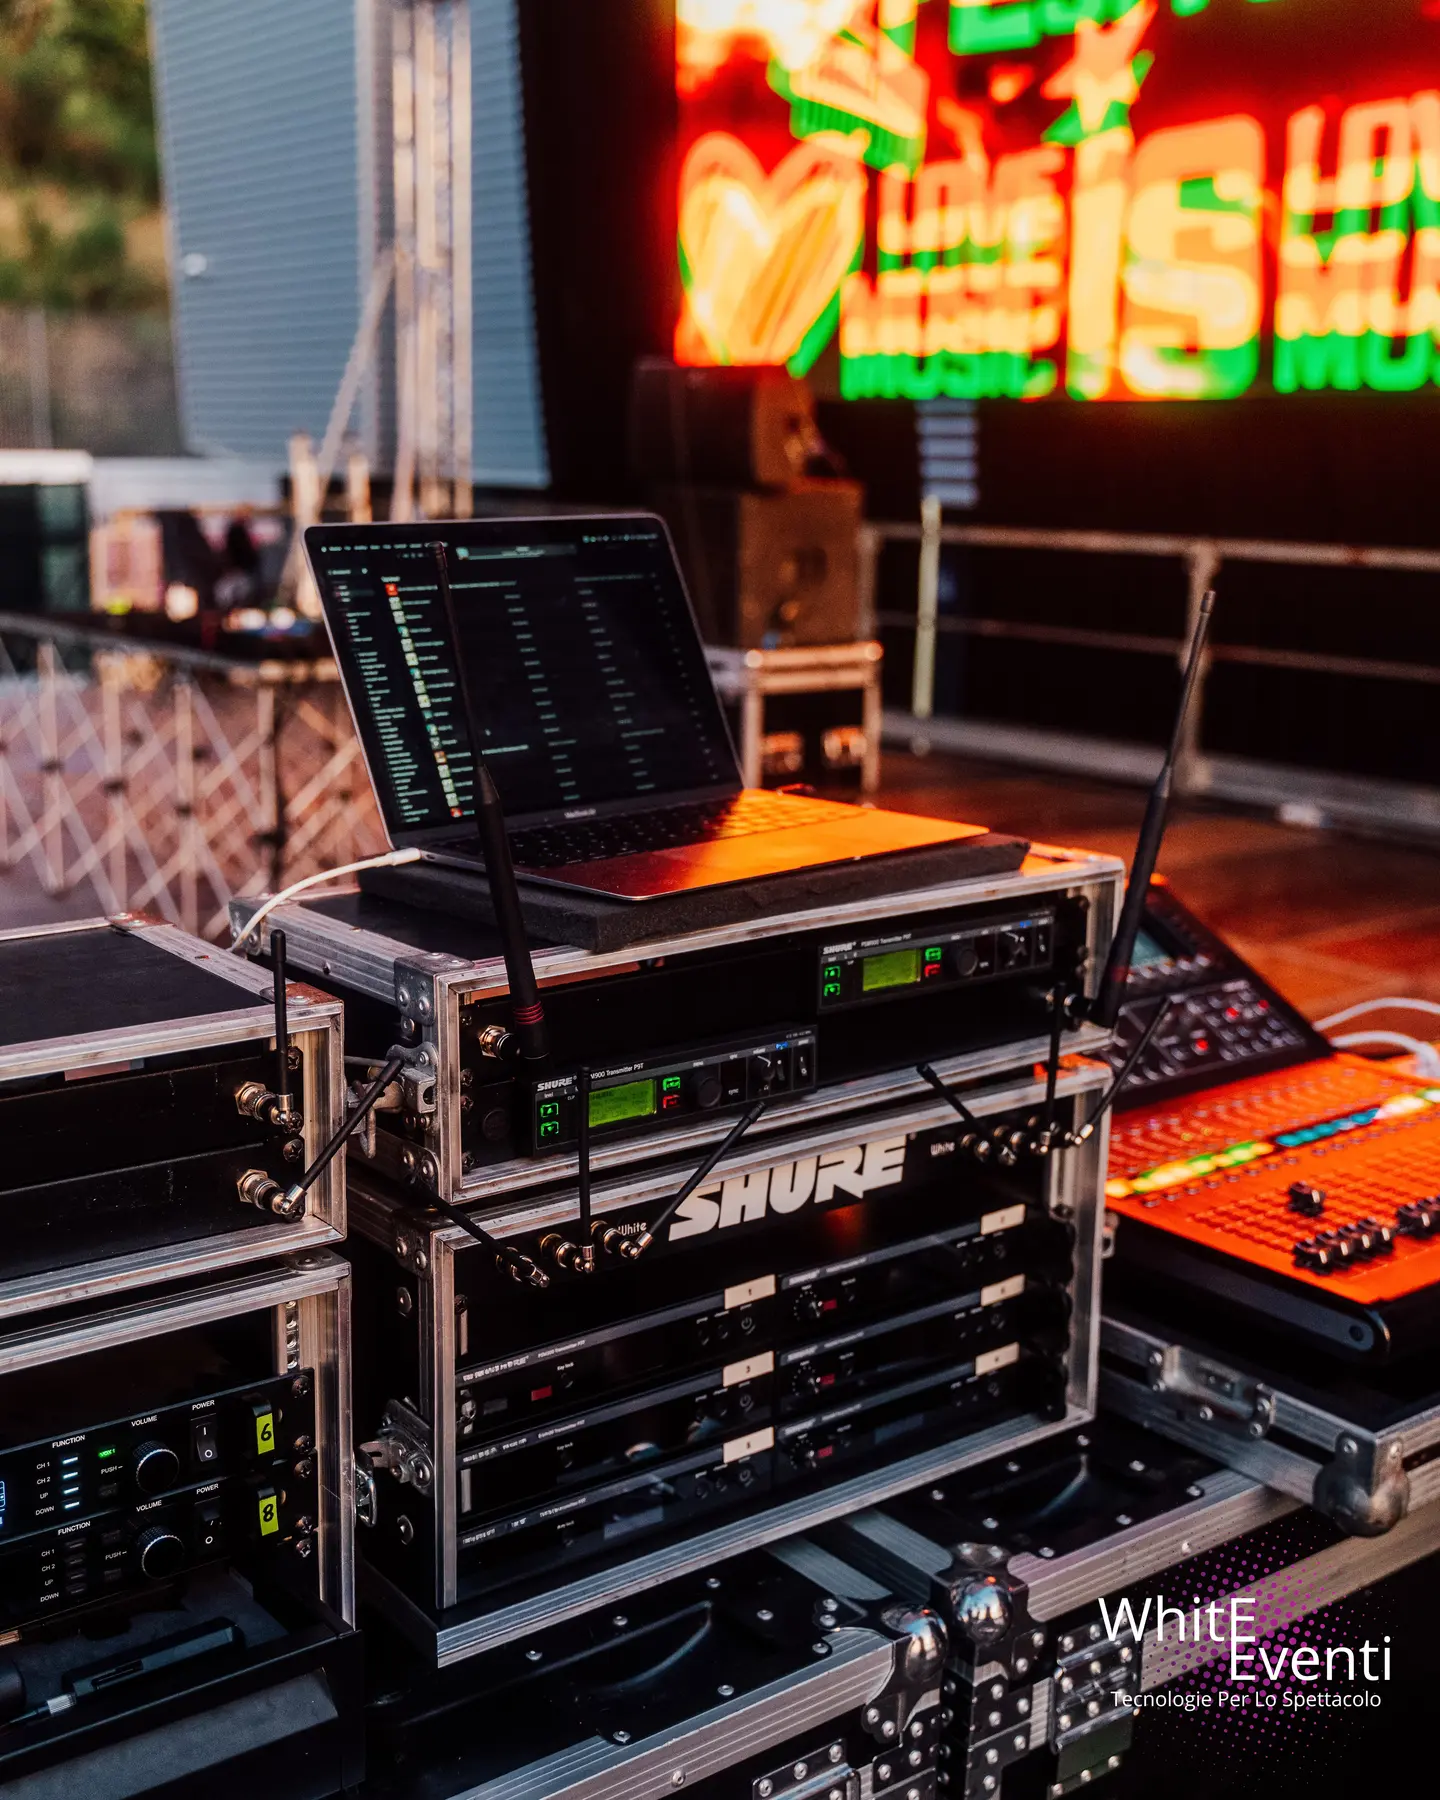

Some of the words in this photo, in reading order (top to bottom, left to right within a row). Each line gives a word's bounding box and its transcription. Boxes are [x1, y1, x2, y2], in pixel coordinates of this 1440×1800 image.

[1066, 112, 1264, 401] IS
[1272, 226, 1440, 394] MU
[536, 1076, 573, 1092] SHURE
[606, 1065, 633, 1077] Transmitter
[668, 1133, 907, 1241] SHURE
[192, 1399, 215, 1411] POWER
[131, 1414, 158, 1427] VOLUME
[260, 1423, 273, 1442] 6
[52, 1434, 86, 1449] FUNCTION
[36, 1462, 46, 1470] CH
[100, 1465, 118, 1475] PUSH
[36, 1477, 47, 1485] CH
[196, 1482, 219, 1495] POWER
[39, 1492, 49, 1500] UP
[35, 1505, 55, 1516] DOWN
[136, 1499, 162, 1513] VOLUME
[262, 1503, 274, 1522] 8
[57, 1520, 91, 1536] FUNCTION
[105, 1550, 122, 1560] PUSH
[41, 1564, 51, 1572] CH
[44, 1578, 54, 1586] UP
[40, 1591, 60, 1603] DOWN
